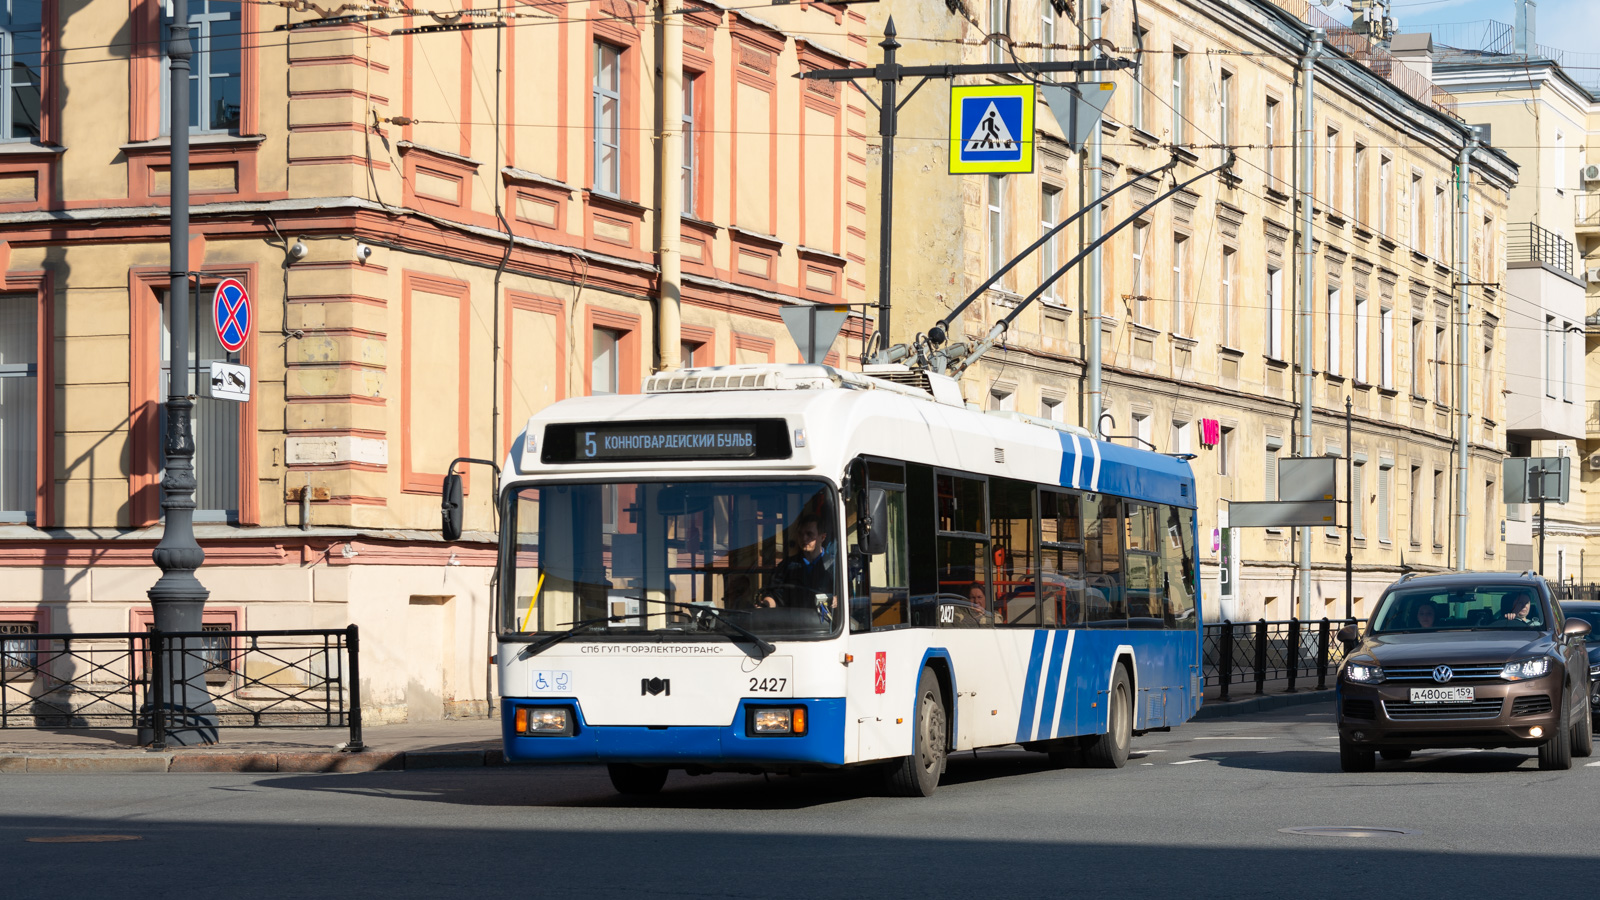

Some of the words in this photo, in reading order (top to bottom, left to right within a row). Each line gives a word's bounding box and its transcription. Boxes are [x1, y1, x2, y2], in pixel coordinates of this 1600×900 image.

[585, 432, 597, 457] 5
[717, 433, 757, 447] БУЛЬВ.
[940, 605, 954, 623] 2427
[601, 645, 621, 653] ГУП
[622, 645, 724, 654] «ГОРЭЛЕКТРОТРАНС»
[749, 677, 788, 692] 2427
